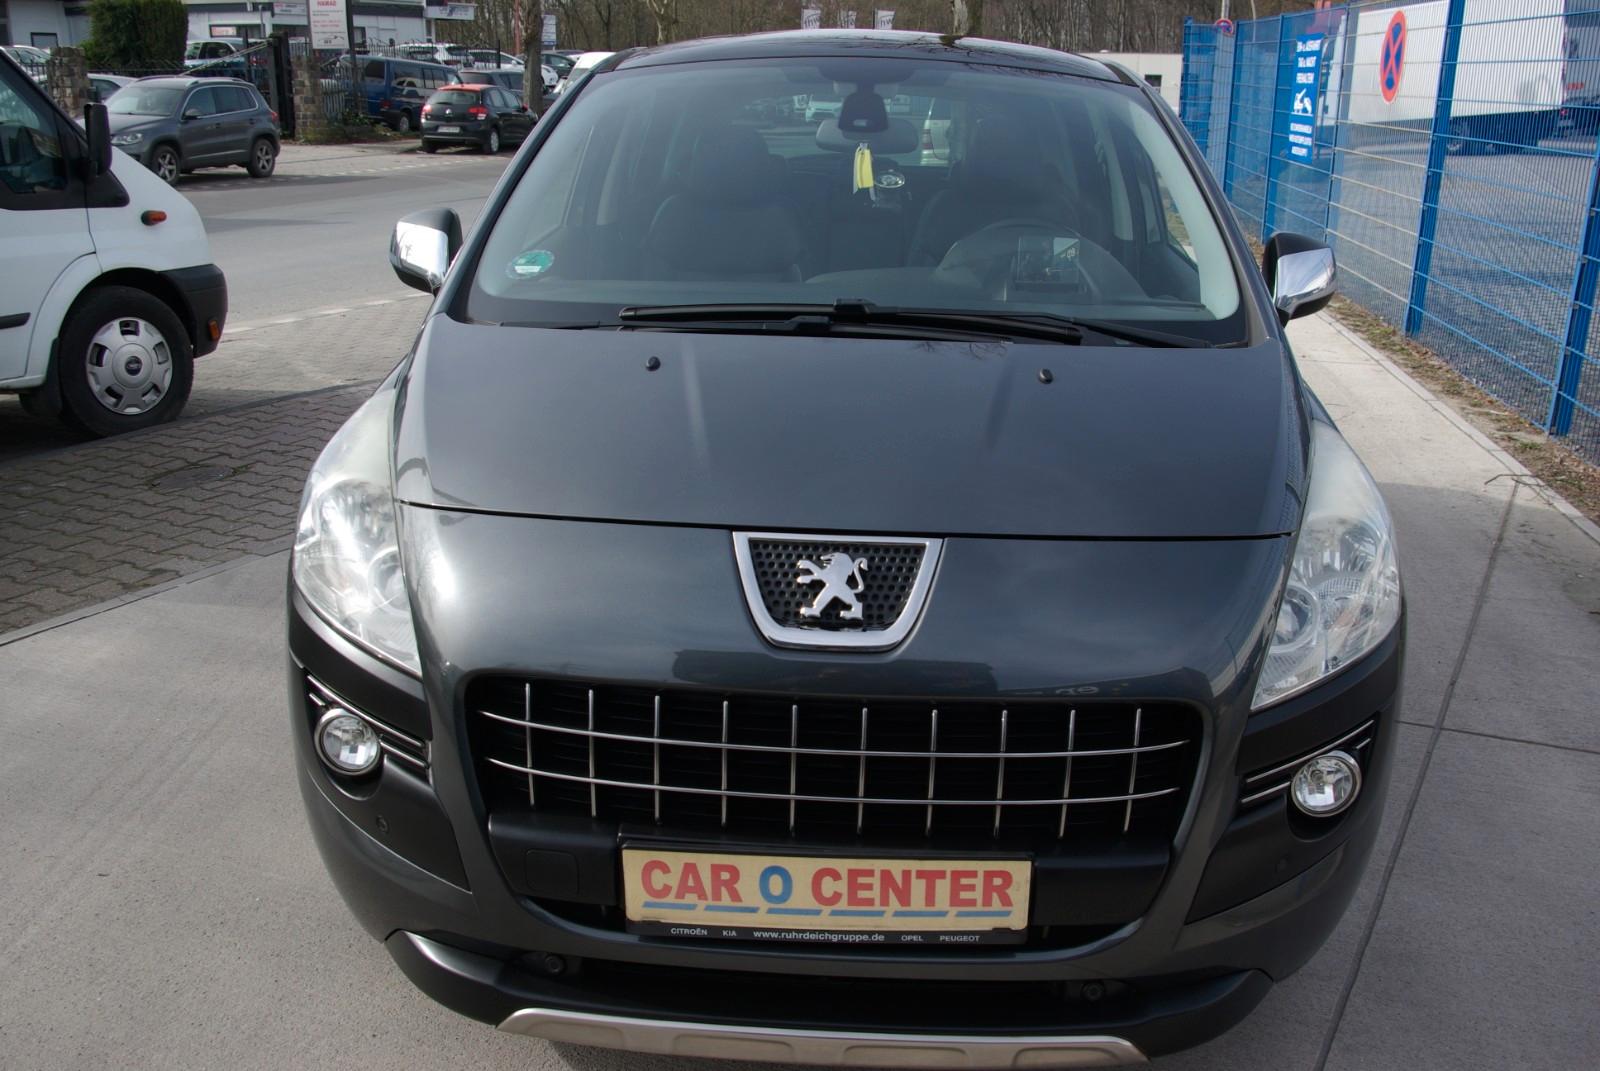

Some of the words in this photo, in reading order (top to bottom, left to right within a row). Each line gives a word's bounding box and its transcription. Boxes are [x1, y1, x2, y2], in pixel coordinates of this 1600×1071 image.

[641, 860, 743, 903] CAR
[758, 865, 793, 905] O
[811, 867, 1014, 908] CENTER
[670, 927, 708, 936] CITROËN
[753, 930, 885, 944] www.ruhrdeichgruppe.de
[939, 935, 981, 943] PEUGEOT
